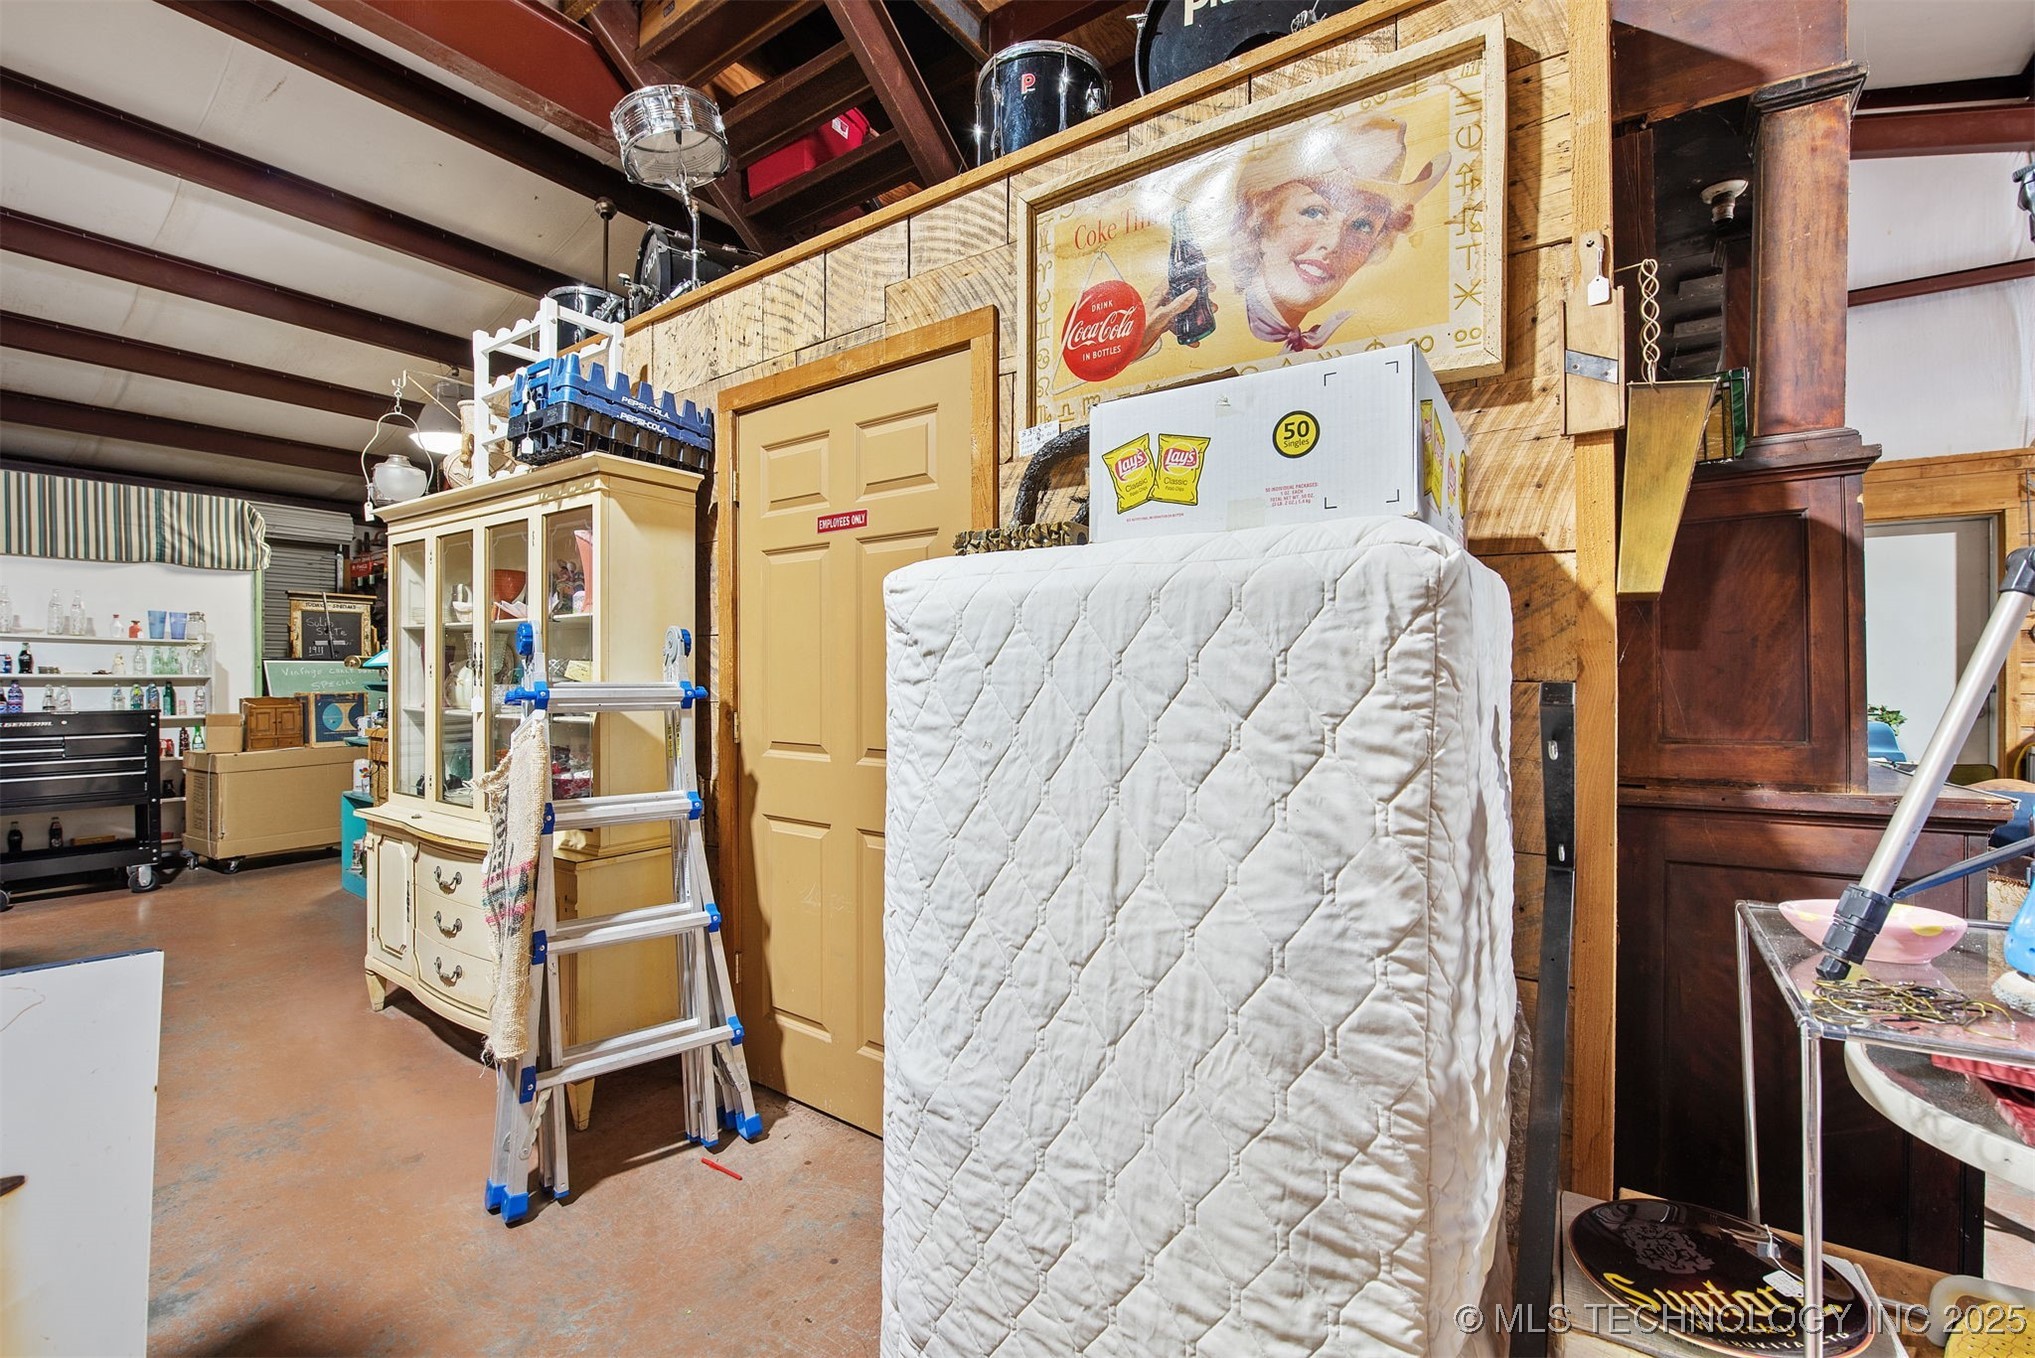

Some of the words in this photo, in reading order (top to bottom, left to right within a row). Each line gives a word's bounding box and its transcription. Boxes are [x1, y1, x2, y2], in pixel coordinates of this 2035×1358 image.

[1073, 219, 1118, 250] Coke
[1091, 299, 1114, 313] DRINK
[1067, 304, 1138, 350] Coca-Cola
[1082, 353, 1091, 362] IN
[1092, 345, 1122, 360] BOTTLES
[621, 395, 671, 420] PEPSI-COLA
[620, 412, 669, 435] PEPSI-COLA
[1283, 420, 1310, 440] 50
[1283, 438, 1310, 449] Singles
[1125, 477, 1148, 492] Classic
[1164, 476, 1188, 486] Classic
[819, 516, 850, 530] EMPLOYEES
[851, 513, 866, 525] ONLY
